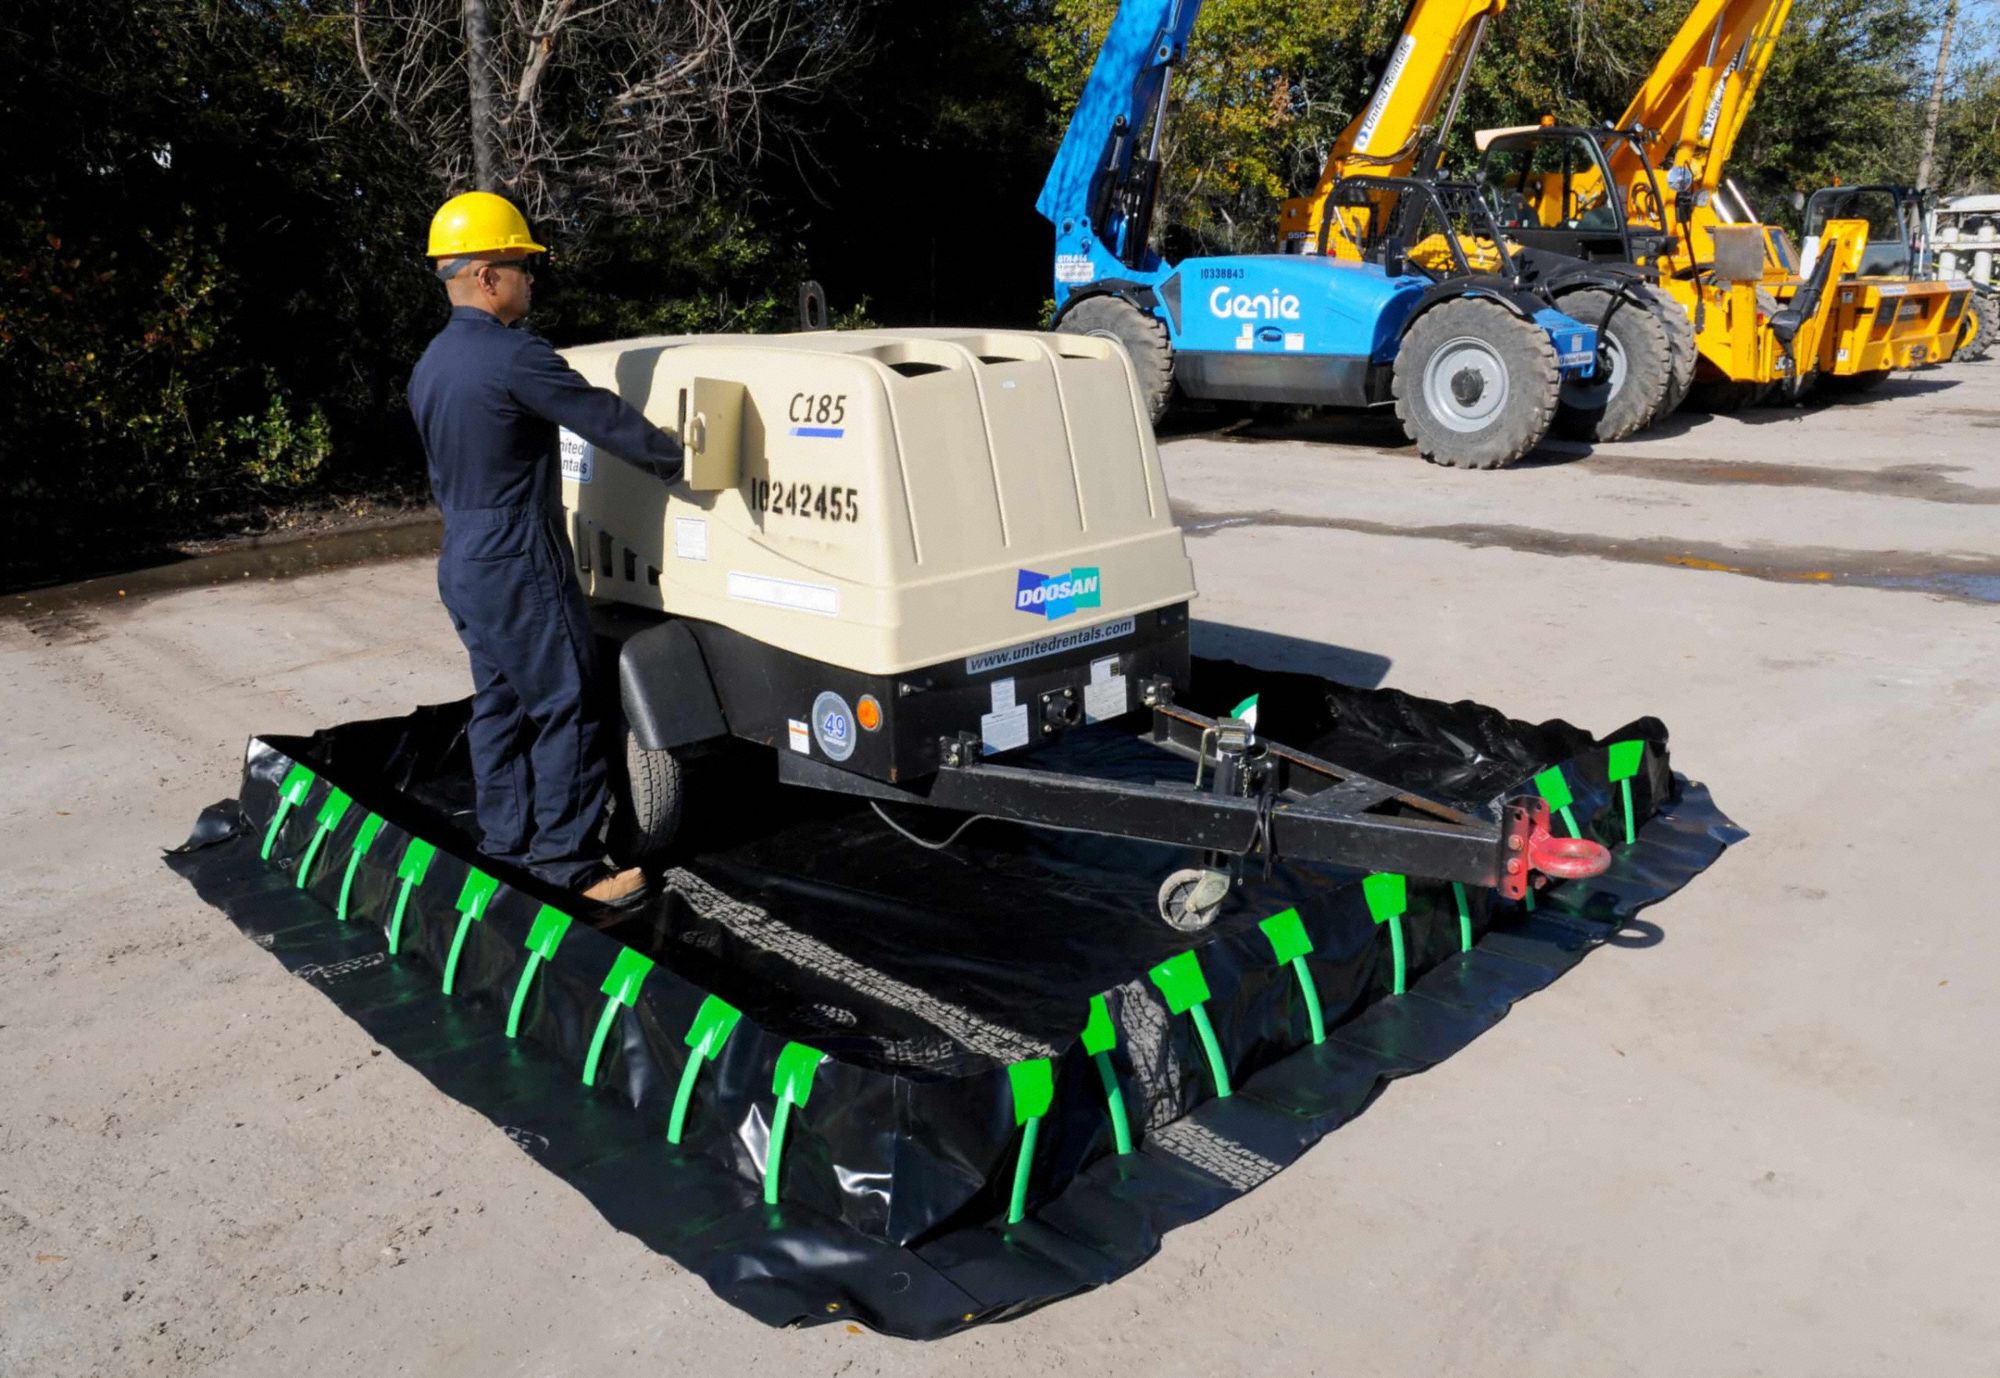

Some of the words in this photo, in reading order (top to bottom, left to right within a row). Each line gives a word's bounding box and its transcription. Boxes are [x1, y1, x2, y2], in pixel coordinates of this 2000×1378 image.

[1364, 86, 1389, 130] United
[1384, 42, 1410, 86] Rentals
[1200, 268, 1245, 279] 10338843
[1209, 285, 1300, 319] Genie
[788, 392, 847, 425] C185
[560, 438, 587, 455] nited
[562, 458, 588, 474] ntals
[752, 477, 858, 523] 10242455
[1017, 575, 1098, 608] DOOSAN
[971, 620, 1133, 671] www.unitedrentals.com
[824, 713, 846, 738] 49
